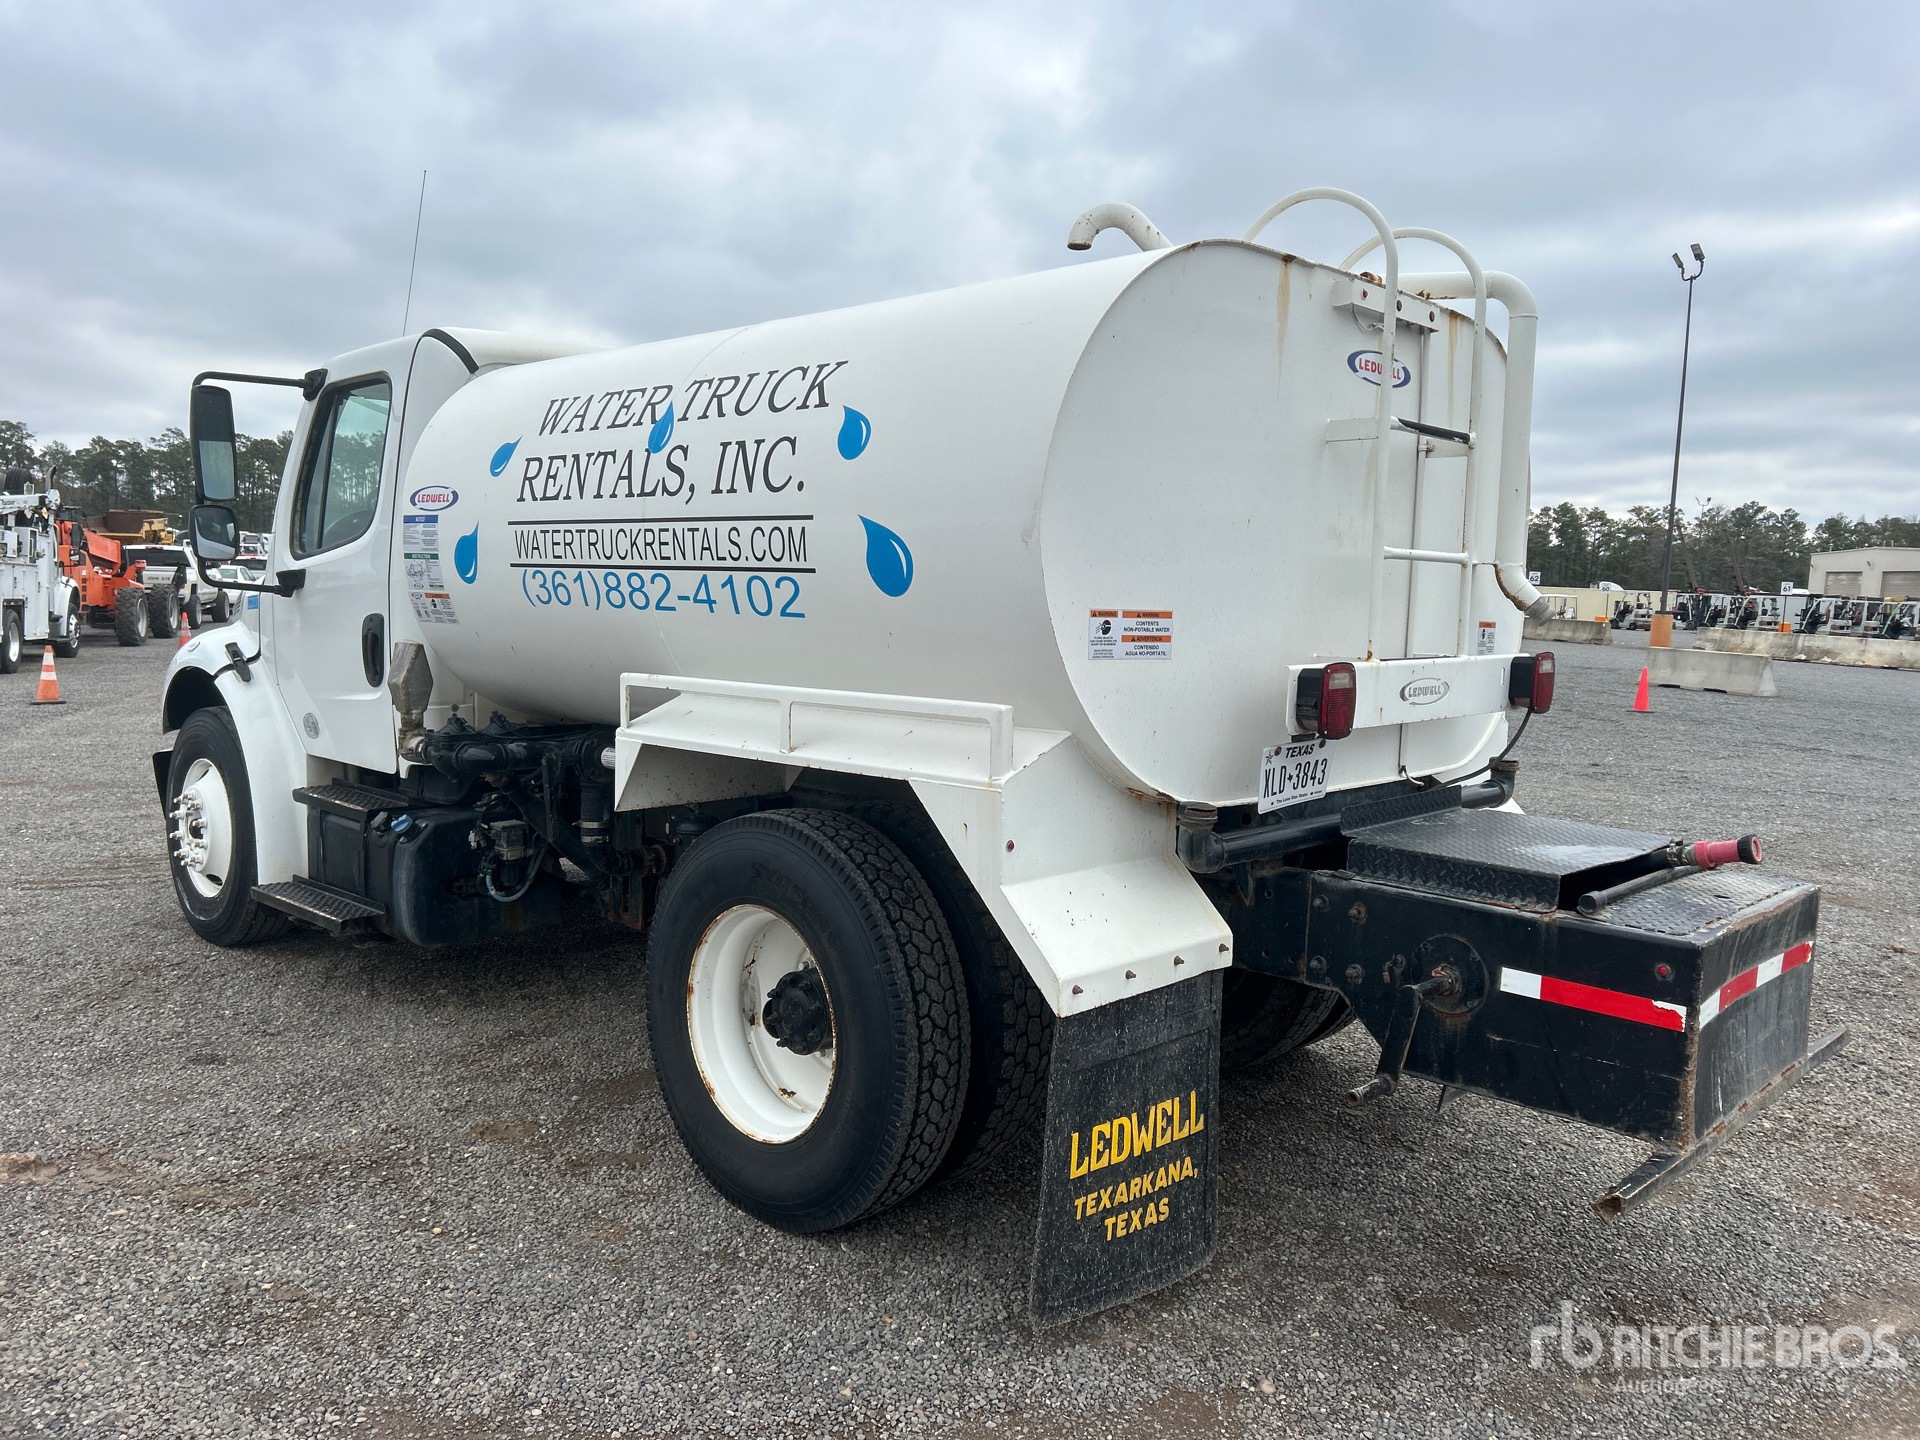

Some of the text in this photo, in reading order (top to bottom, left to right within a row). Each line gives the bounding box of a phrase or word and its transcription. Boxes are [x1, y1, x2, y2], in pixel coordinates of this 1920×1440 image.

[1358, 358, 1402, 380] LEDWLL
[538, 360, 849, 436] WATER TRUCK
[517, 436, 805, 505] RENTALS, INC.
[417, 493, 450, 503] LEDWELL
[514, 526, 807, 562] WATERTRUCKRENTALS.COM
[521, 568, 806, 618] (361)882-4102
[1408, 685, 1442, 698] LEDWELL
[1285, 744, 1316, 758] TEXAS
[1069, 1090, 1205, 1180] LEDWELL
[1074, 1156, 1199, 1221] TEXARKANA,
[1104, 1197, 1170, 1242] TEXAS
